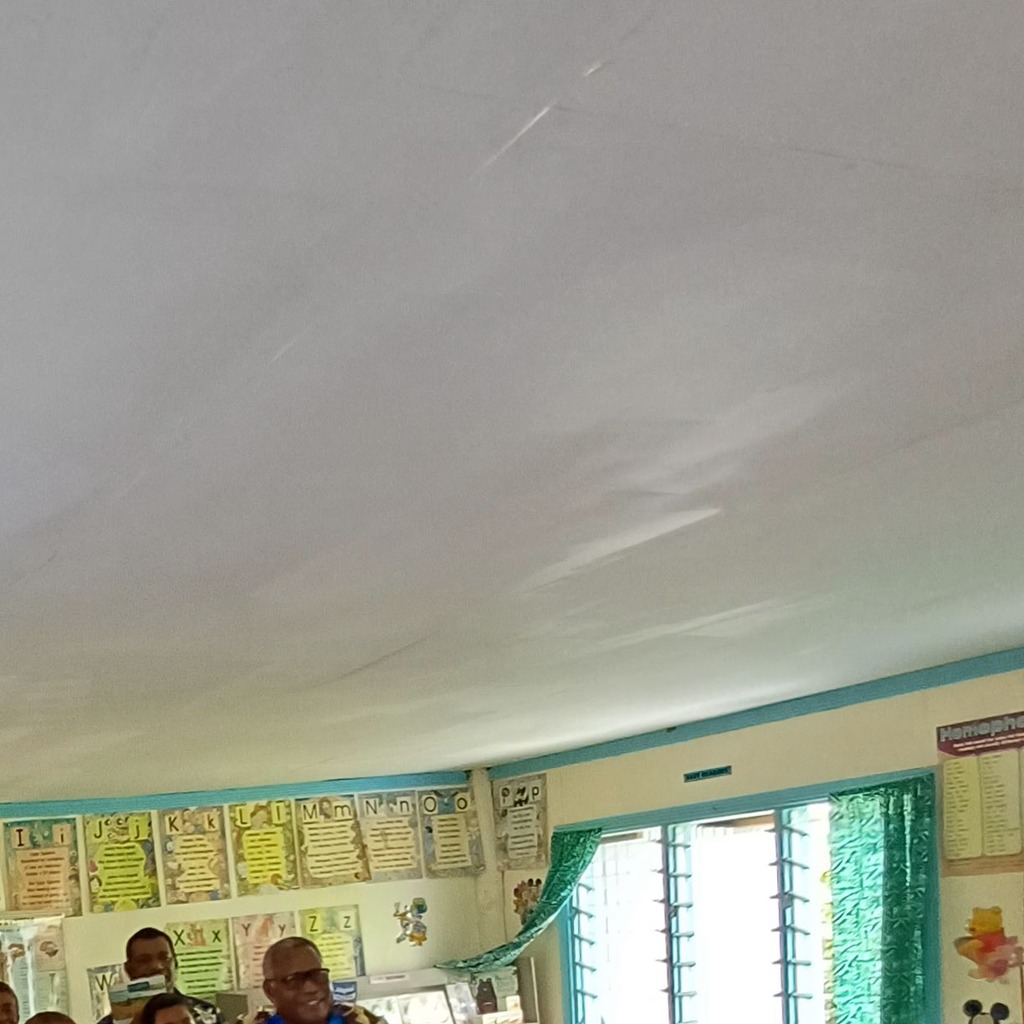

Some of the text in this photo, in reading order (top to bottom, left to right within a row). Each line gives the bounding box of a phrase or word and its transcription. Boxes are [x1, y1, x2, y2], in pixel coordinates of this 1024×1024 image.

[303, 803, 318, 820] M
[365, 800, 378, 815] N
[424, 796, 437, 812] O
[168, 816, 179, 833] K
[239, 808, 248, 824] L
[16, 828, 65, 847] I i
[94, 820, 103, 839] J
[241, 923, 251, 937] Y
[308, 915, 319, 933] Z
[173, 929, 186, 946] X
